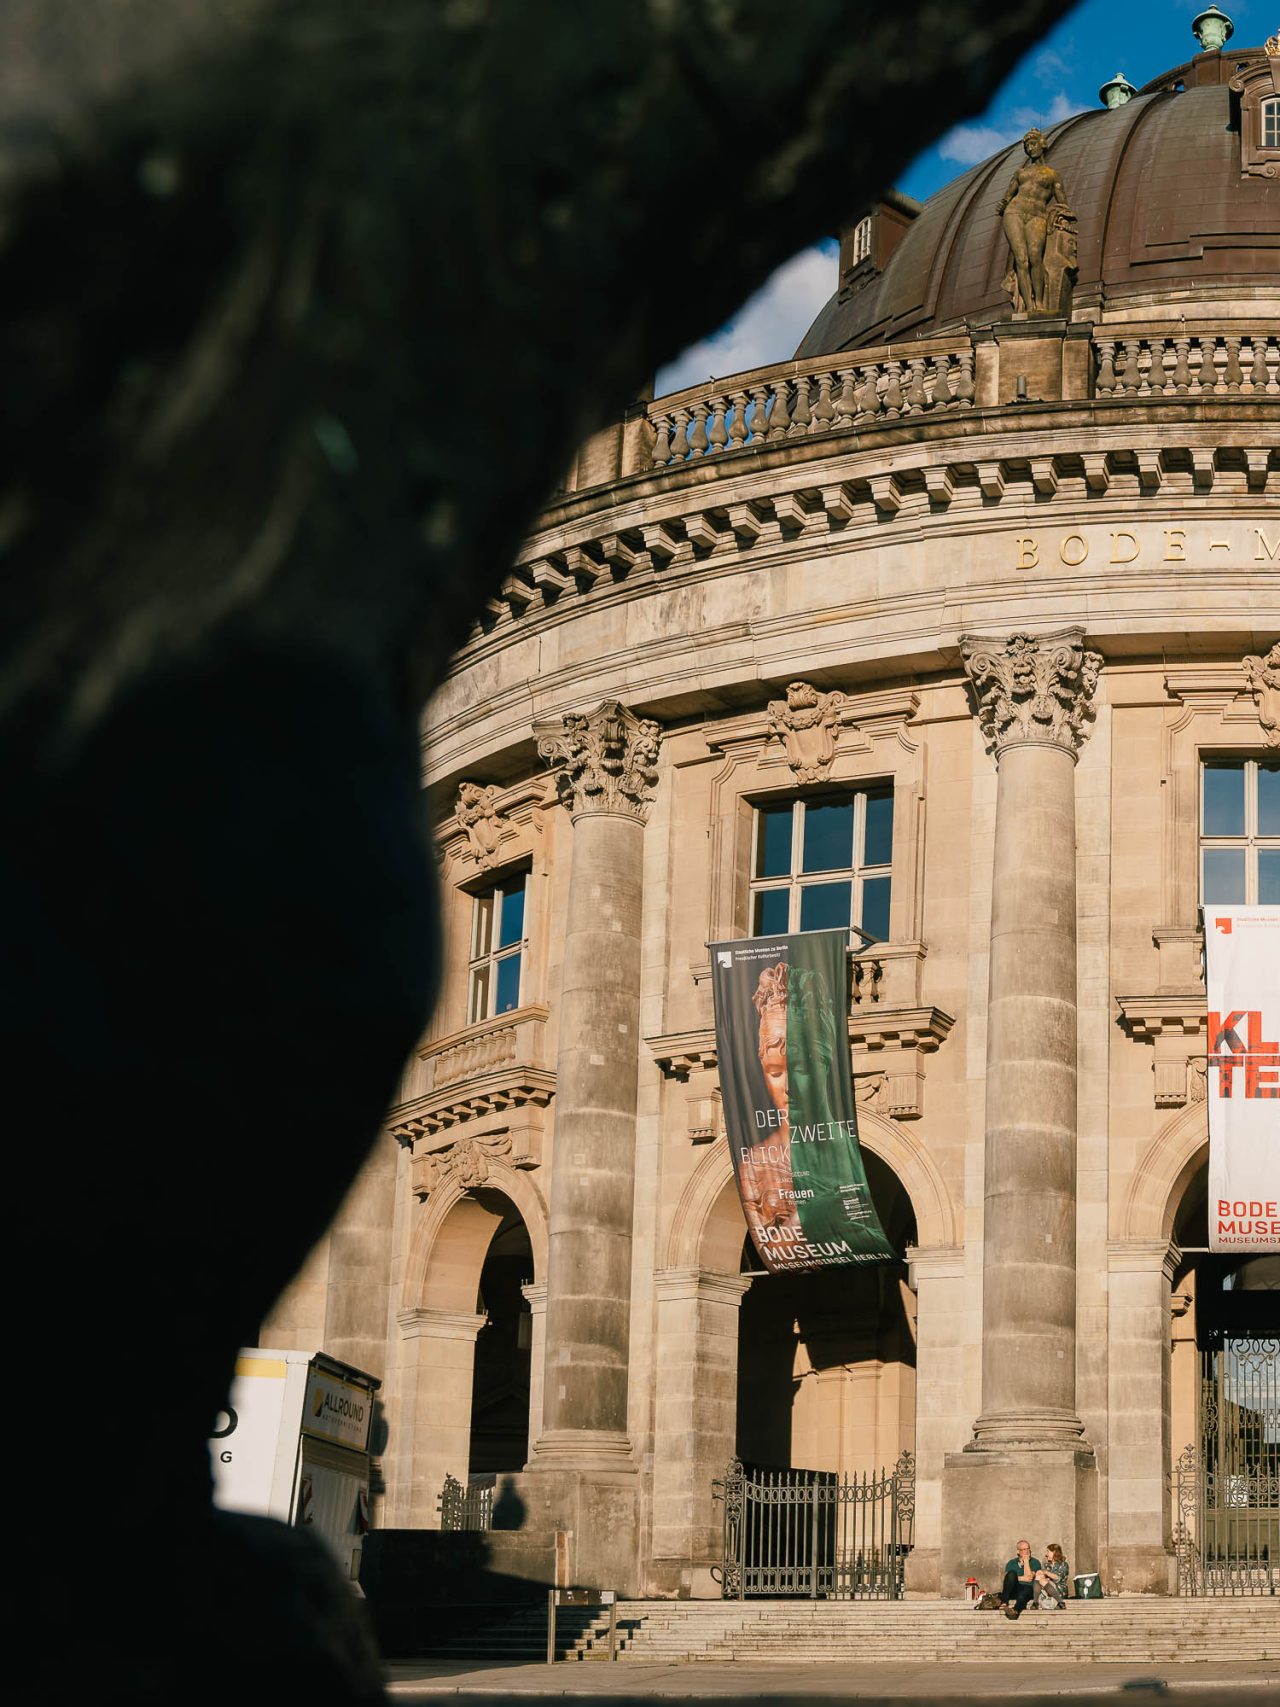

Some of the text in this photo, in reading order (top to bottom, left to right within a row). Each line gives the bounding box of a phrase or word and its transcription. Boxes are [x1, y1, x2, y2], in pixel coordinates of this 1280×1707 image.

[755, 1108, 790, 1128] DER
[789, 1120, 856, 1144] ZWEITE
[740, 1144, 791, 1164] BLICK
[778, 1188, 815, 1200] Frauen
[1217, 1200, 1277, 1217] BODE
[755, 1225, 807, 1242] BODE
[763, 1241, 852, 1261] MUSEUM
[773, 1253, 892, 1270] MUSEUMSINSEL BERLIN
[324, 1392, 364, 1422] ALLROUND
